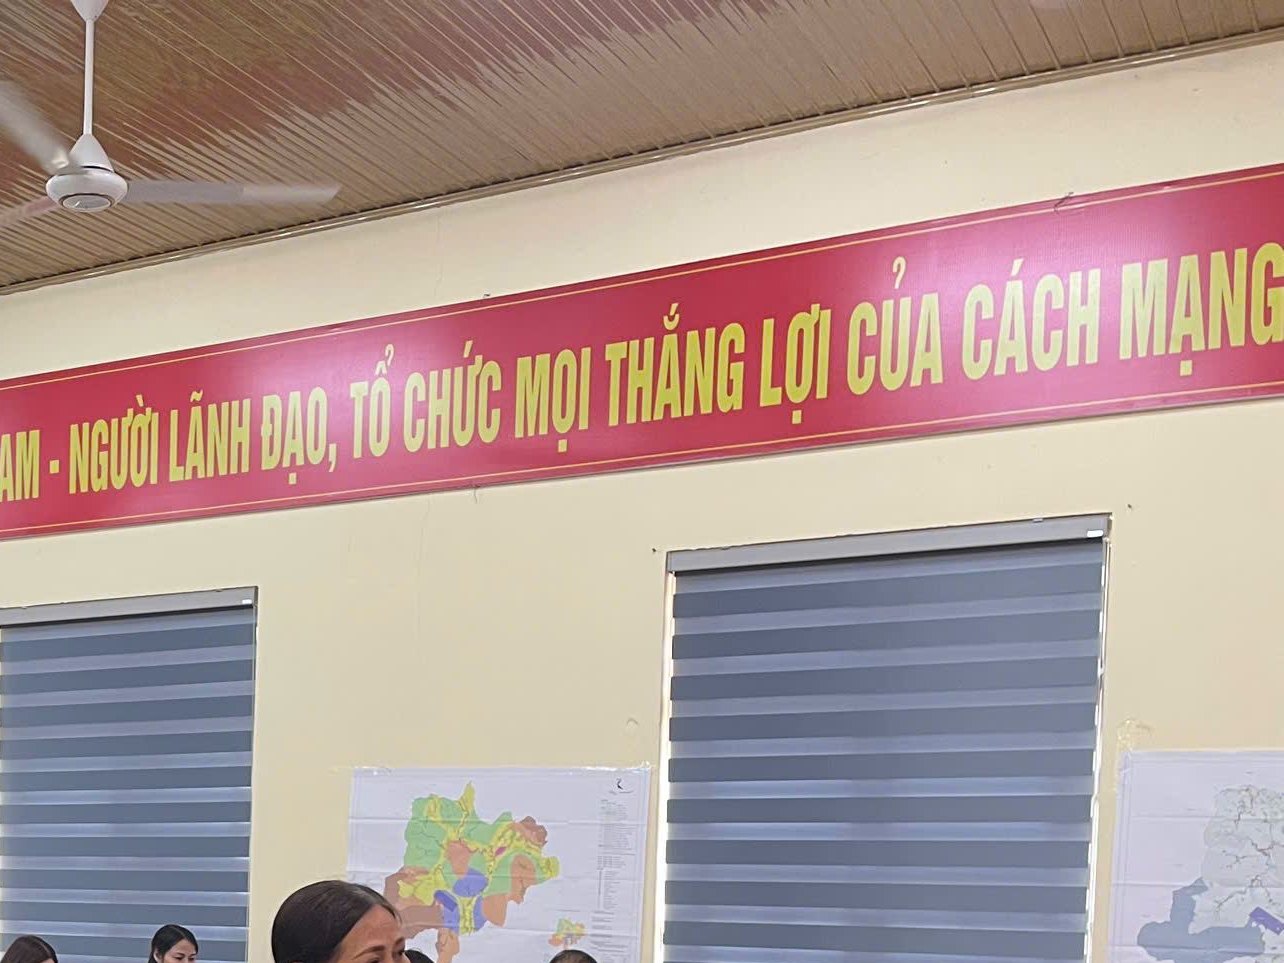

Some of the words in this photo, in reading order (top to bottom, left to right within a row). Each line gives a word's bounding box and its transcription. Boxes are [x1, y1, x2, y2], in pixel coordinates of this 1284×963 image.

[50, 460, 60, 474] -
[69, 394, 159, 494] NGƯỜI
[169, 390, 252, 483] LÃNH
[260, 386, 337, 486] ĐẠO,
[350, 344, 395, 459] TỔ
[403, 340, 502, 454] CHỨC
[515, 347, 591, 453] MỌI
[605, 303, 745, 427] THẮNG
[760, 303, 831, 425] LỢI
[847, 256, 944, 396] CỦA
[961, 258, 1100, 381] CÁCH
[1120, 242, 1284, 377] MẠNG
